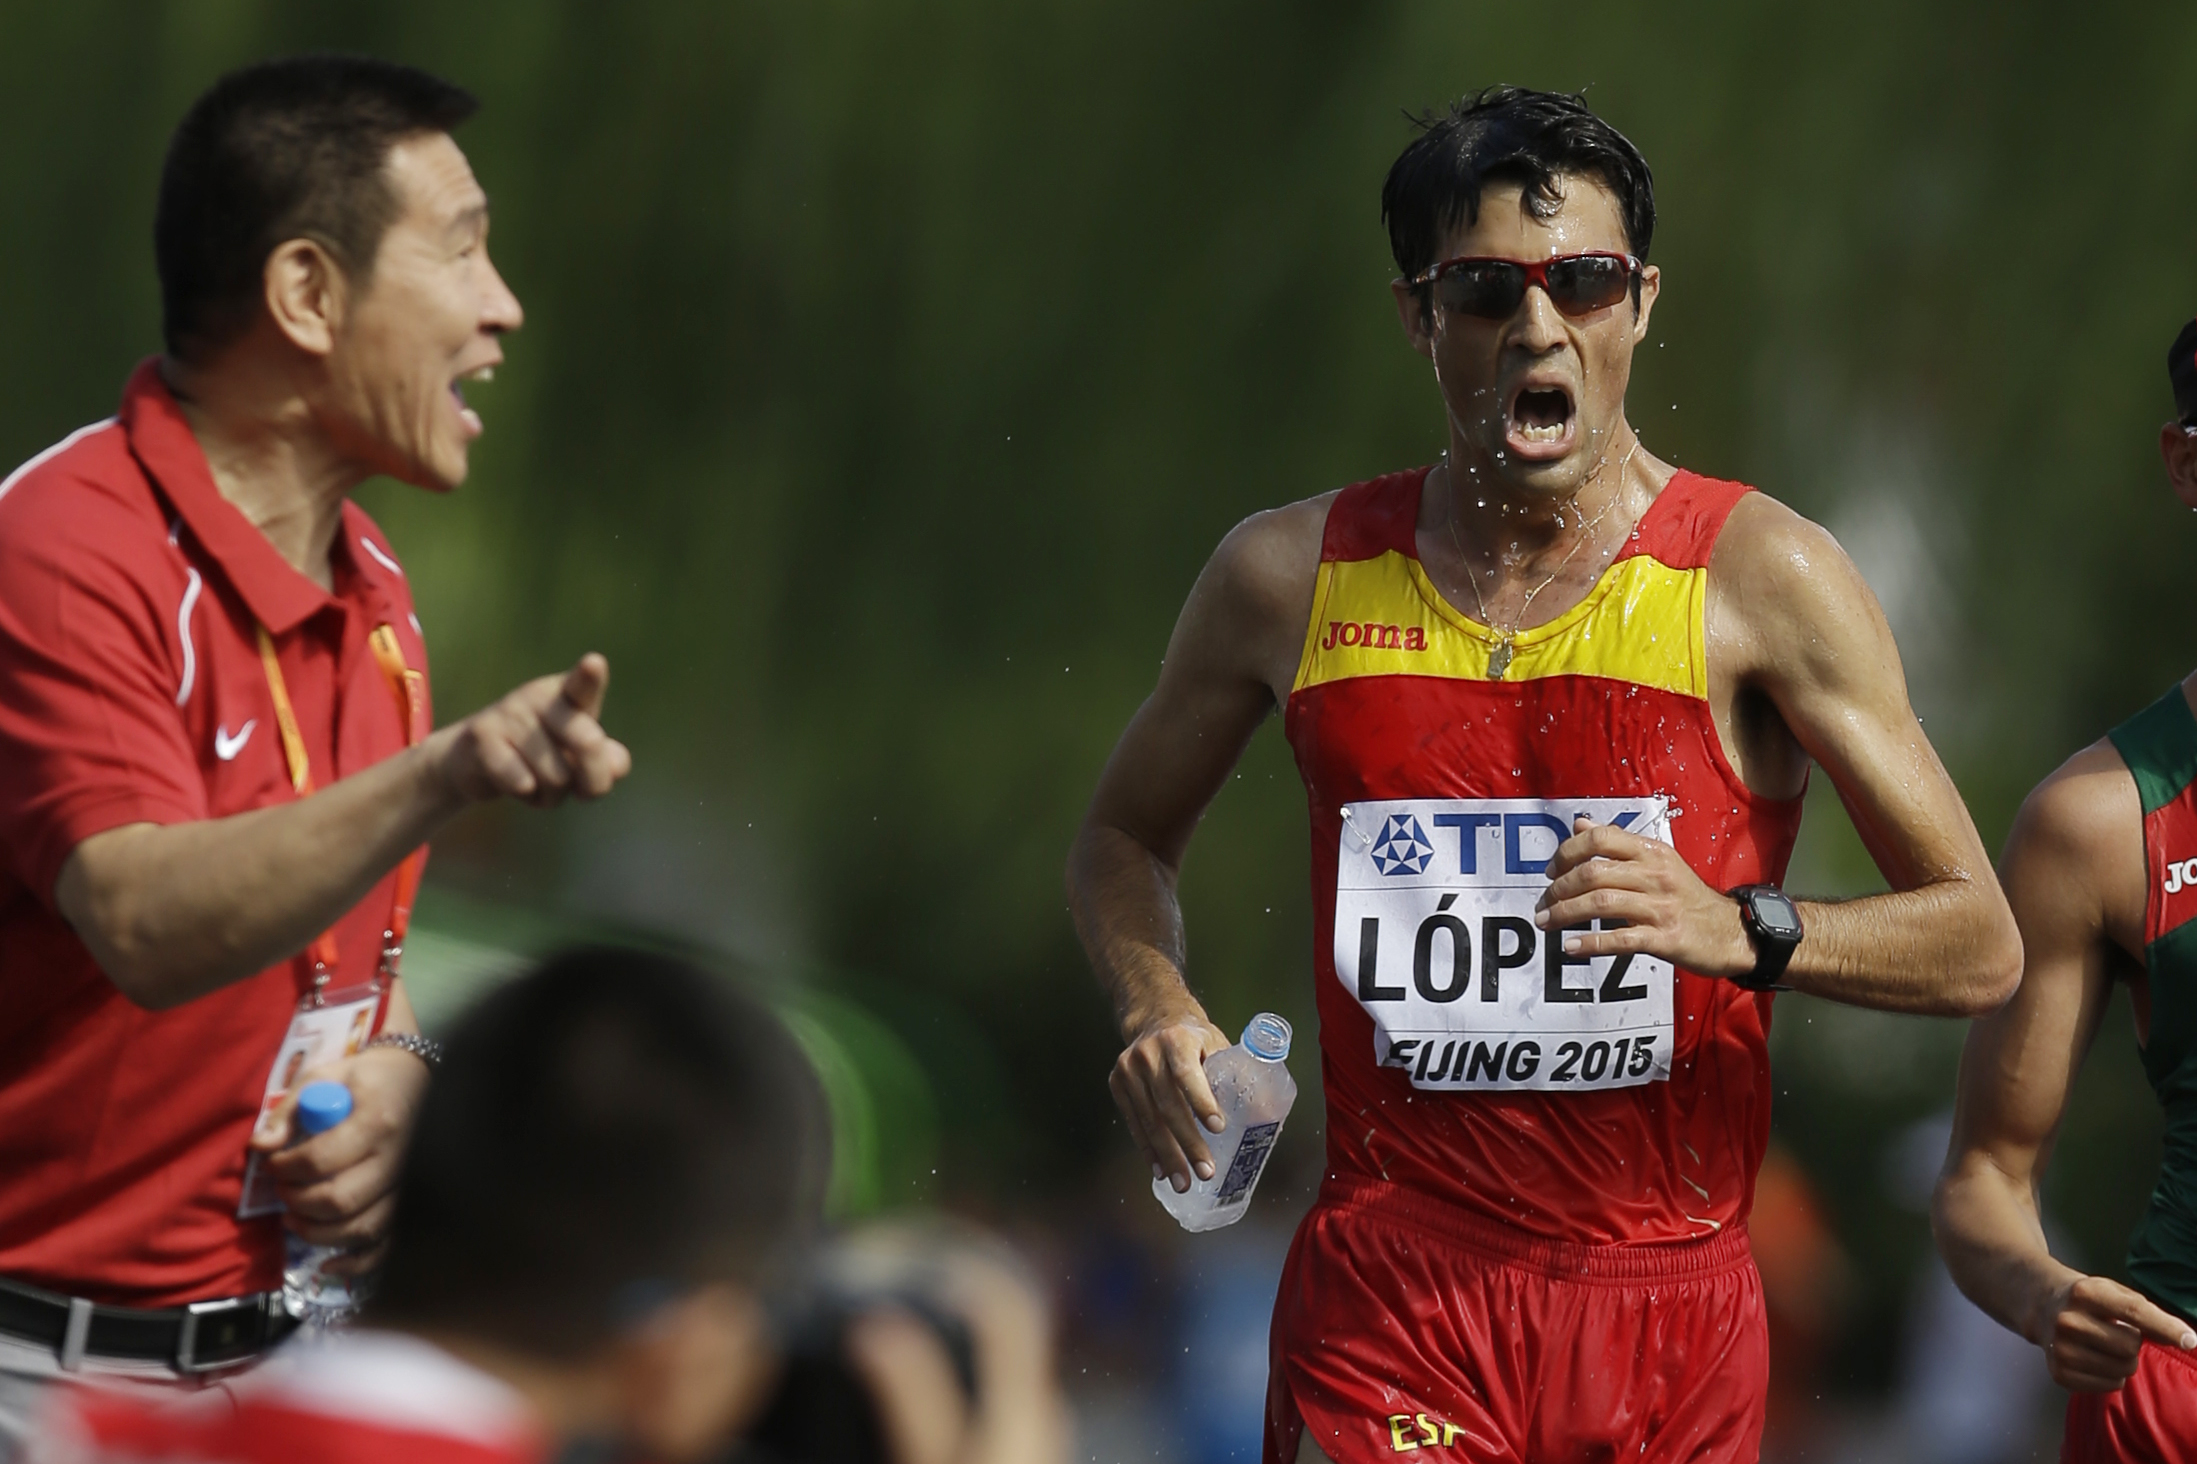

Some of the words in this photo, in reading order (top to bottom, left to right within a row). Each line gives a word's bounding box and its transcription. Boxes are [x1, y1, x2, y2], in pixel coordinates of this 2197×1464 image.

[1433, 812, 1642, 876] TD
[1358, 893, 1648, 1004] LÓPEZ
[1549, 1035, 1658, 1082] 2015
